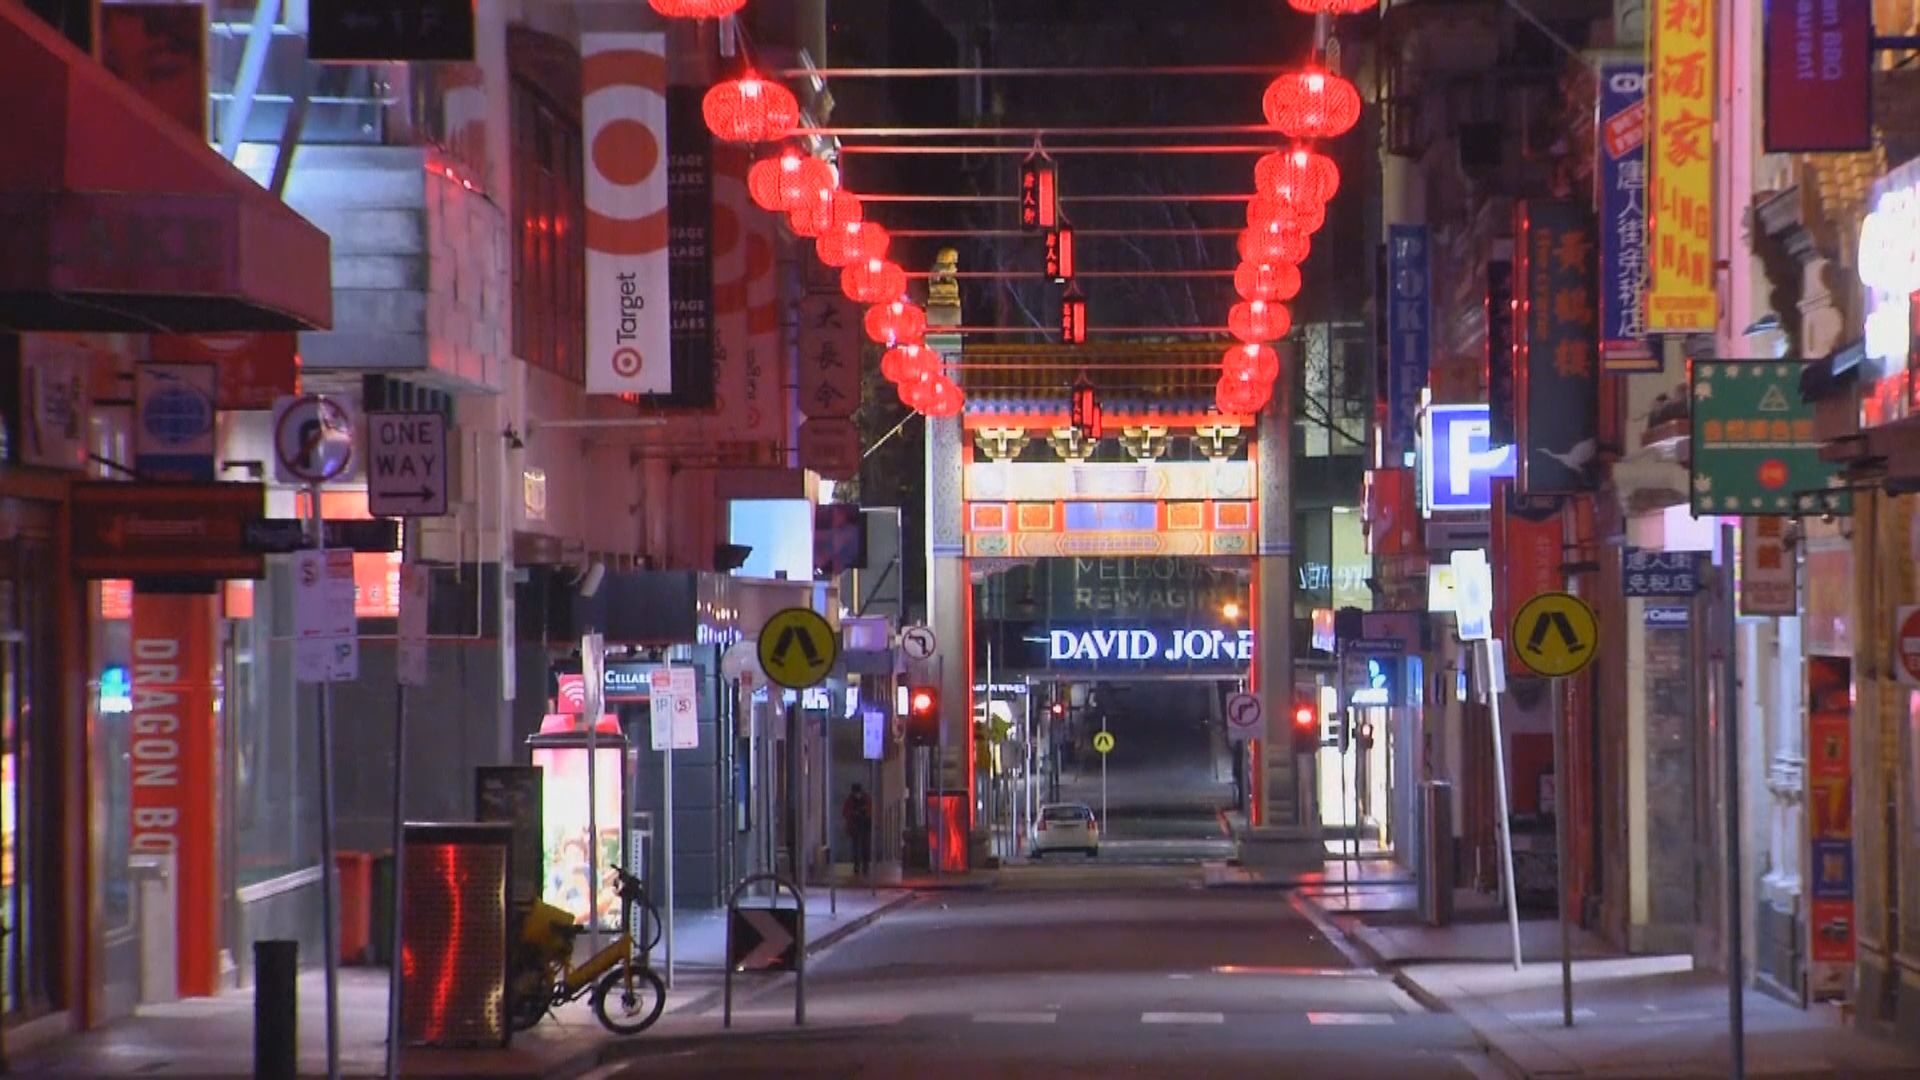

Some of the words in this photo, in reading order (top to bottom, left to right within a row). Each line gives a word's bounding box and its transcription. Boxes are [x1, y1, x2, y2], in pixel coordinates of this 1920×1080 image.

[616, 271, 644, 345] Target
[380, 421, 433, 446] ONE
[376, 454, 437, 478] WAY
[1050, 630, 1158, 660] DAVID
[134, 638, 178, 786] DRAGON
